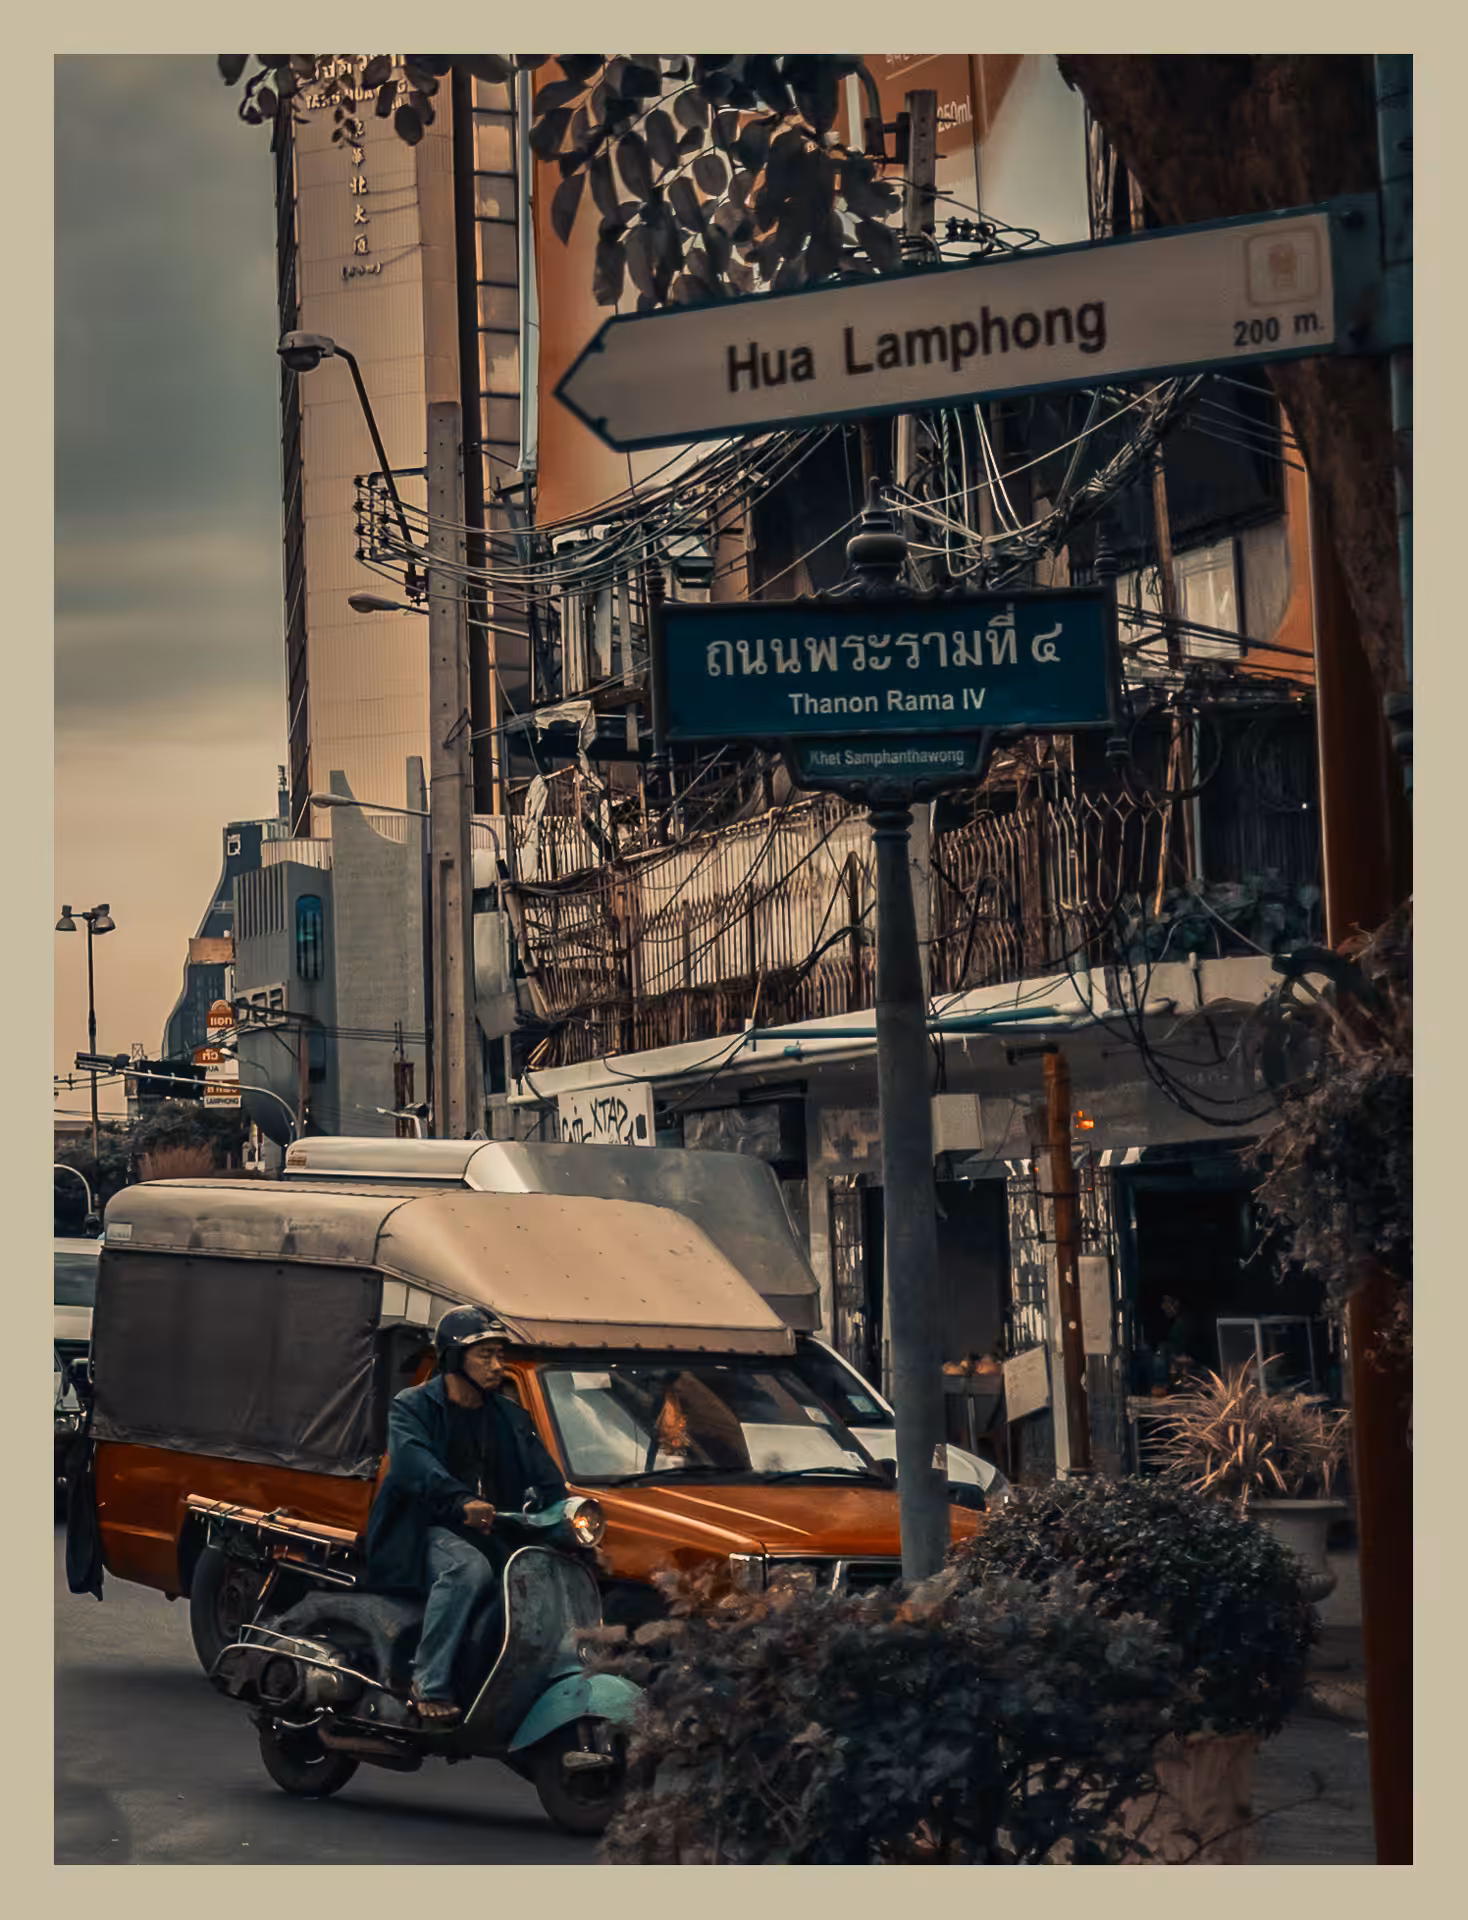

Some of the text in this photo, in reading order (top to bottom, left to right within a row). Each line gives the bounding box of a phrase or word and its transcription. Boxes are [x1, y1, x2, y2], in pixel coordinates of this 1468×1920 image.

[727, 301, 1107, 393] Hua Lamphong
[1233, 312, 1325, 347] 200 m.
[706, 603, 1063, 677] ถนนพระรามที่ ๔
[788, 688, 985, 715] Thanon Rama IV
[810, 749, 964, 767] Khet Samphanthawong
